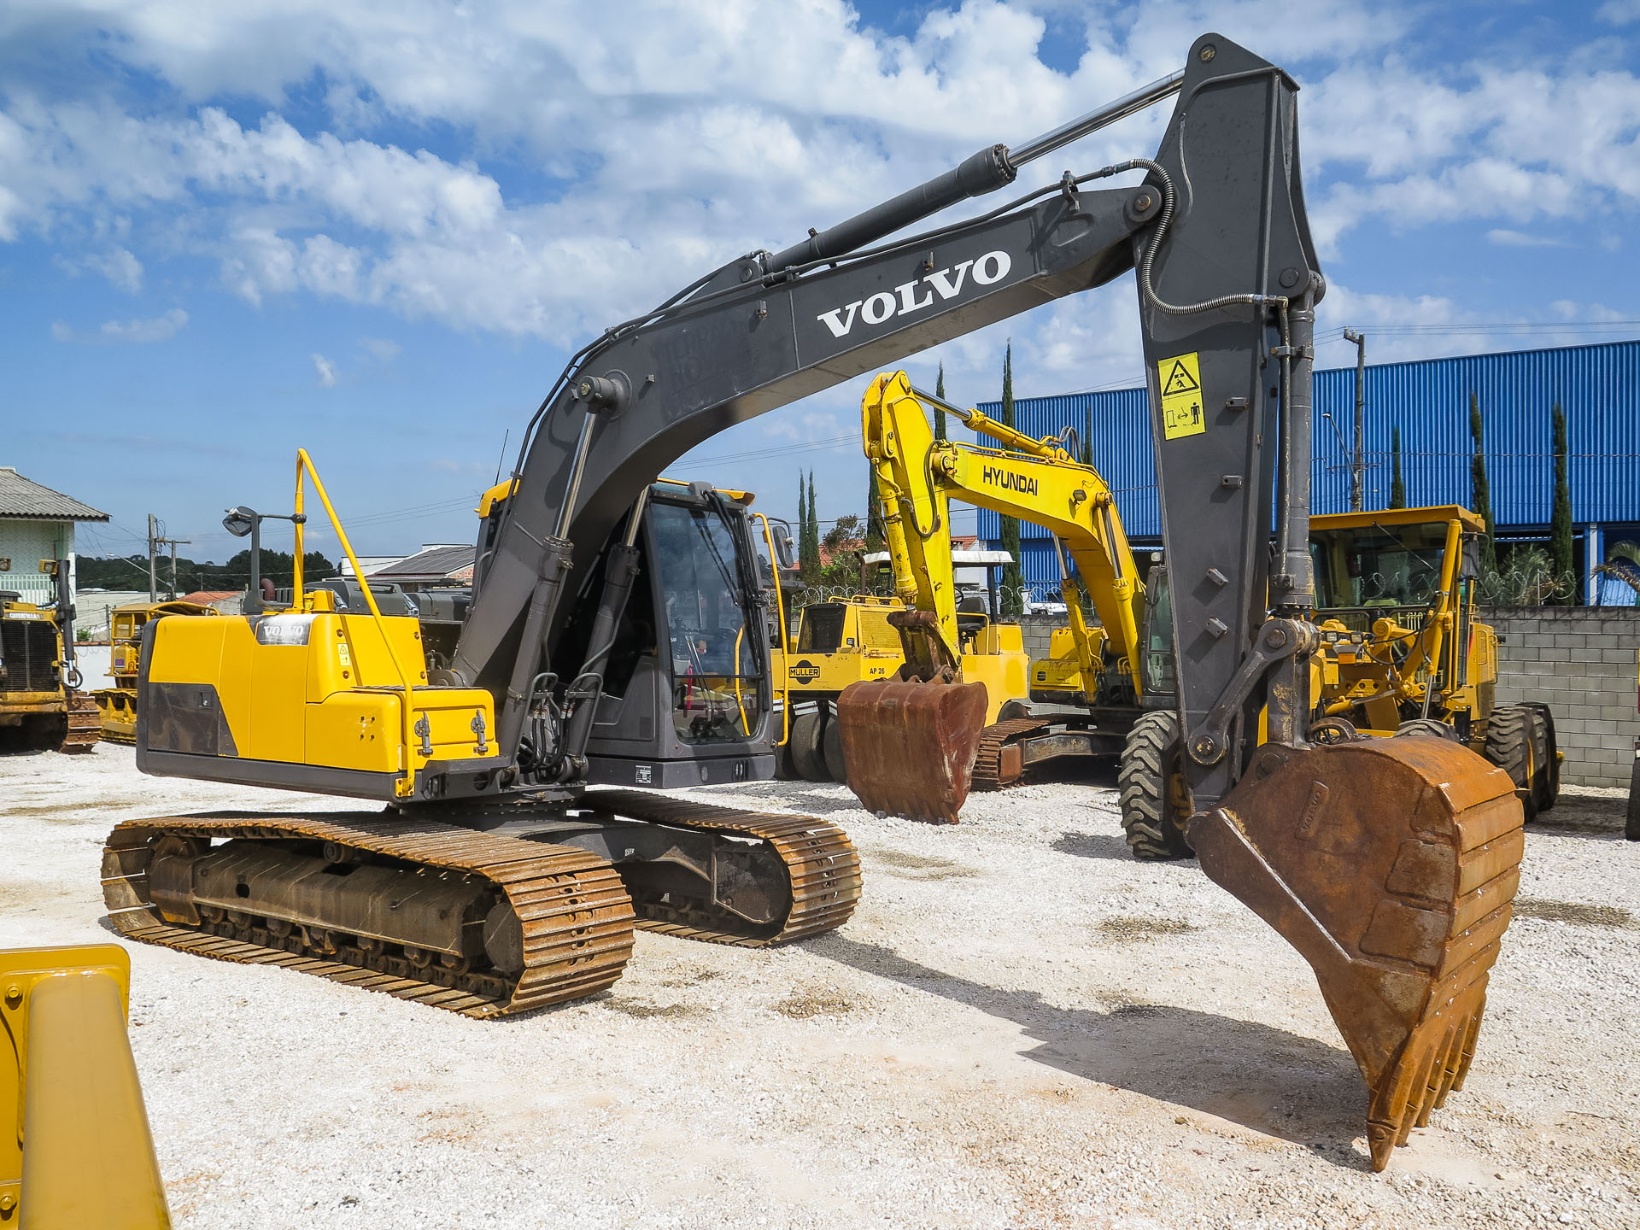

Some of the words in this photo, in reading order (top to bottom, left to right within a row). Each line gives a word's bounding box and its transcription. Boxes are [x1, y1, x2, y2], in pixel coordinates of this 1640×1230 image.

[817, 250, 1011, 338] VOLVO
[983, 465, 1038, 496] HYUNDAI
[789, 668, 819, 676] MULLER
[869, 667, 877, 675] AP
[878, 667, 885, 675] 26
